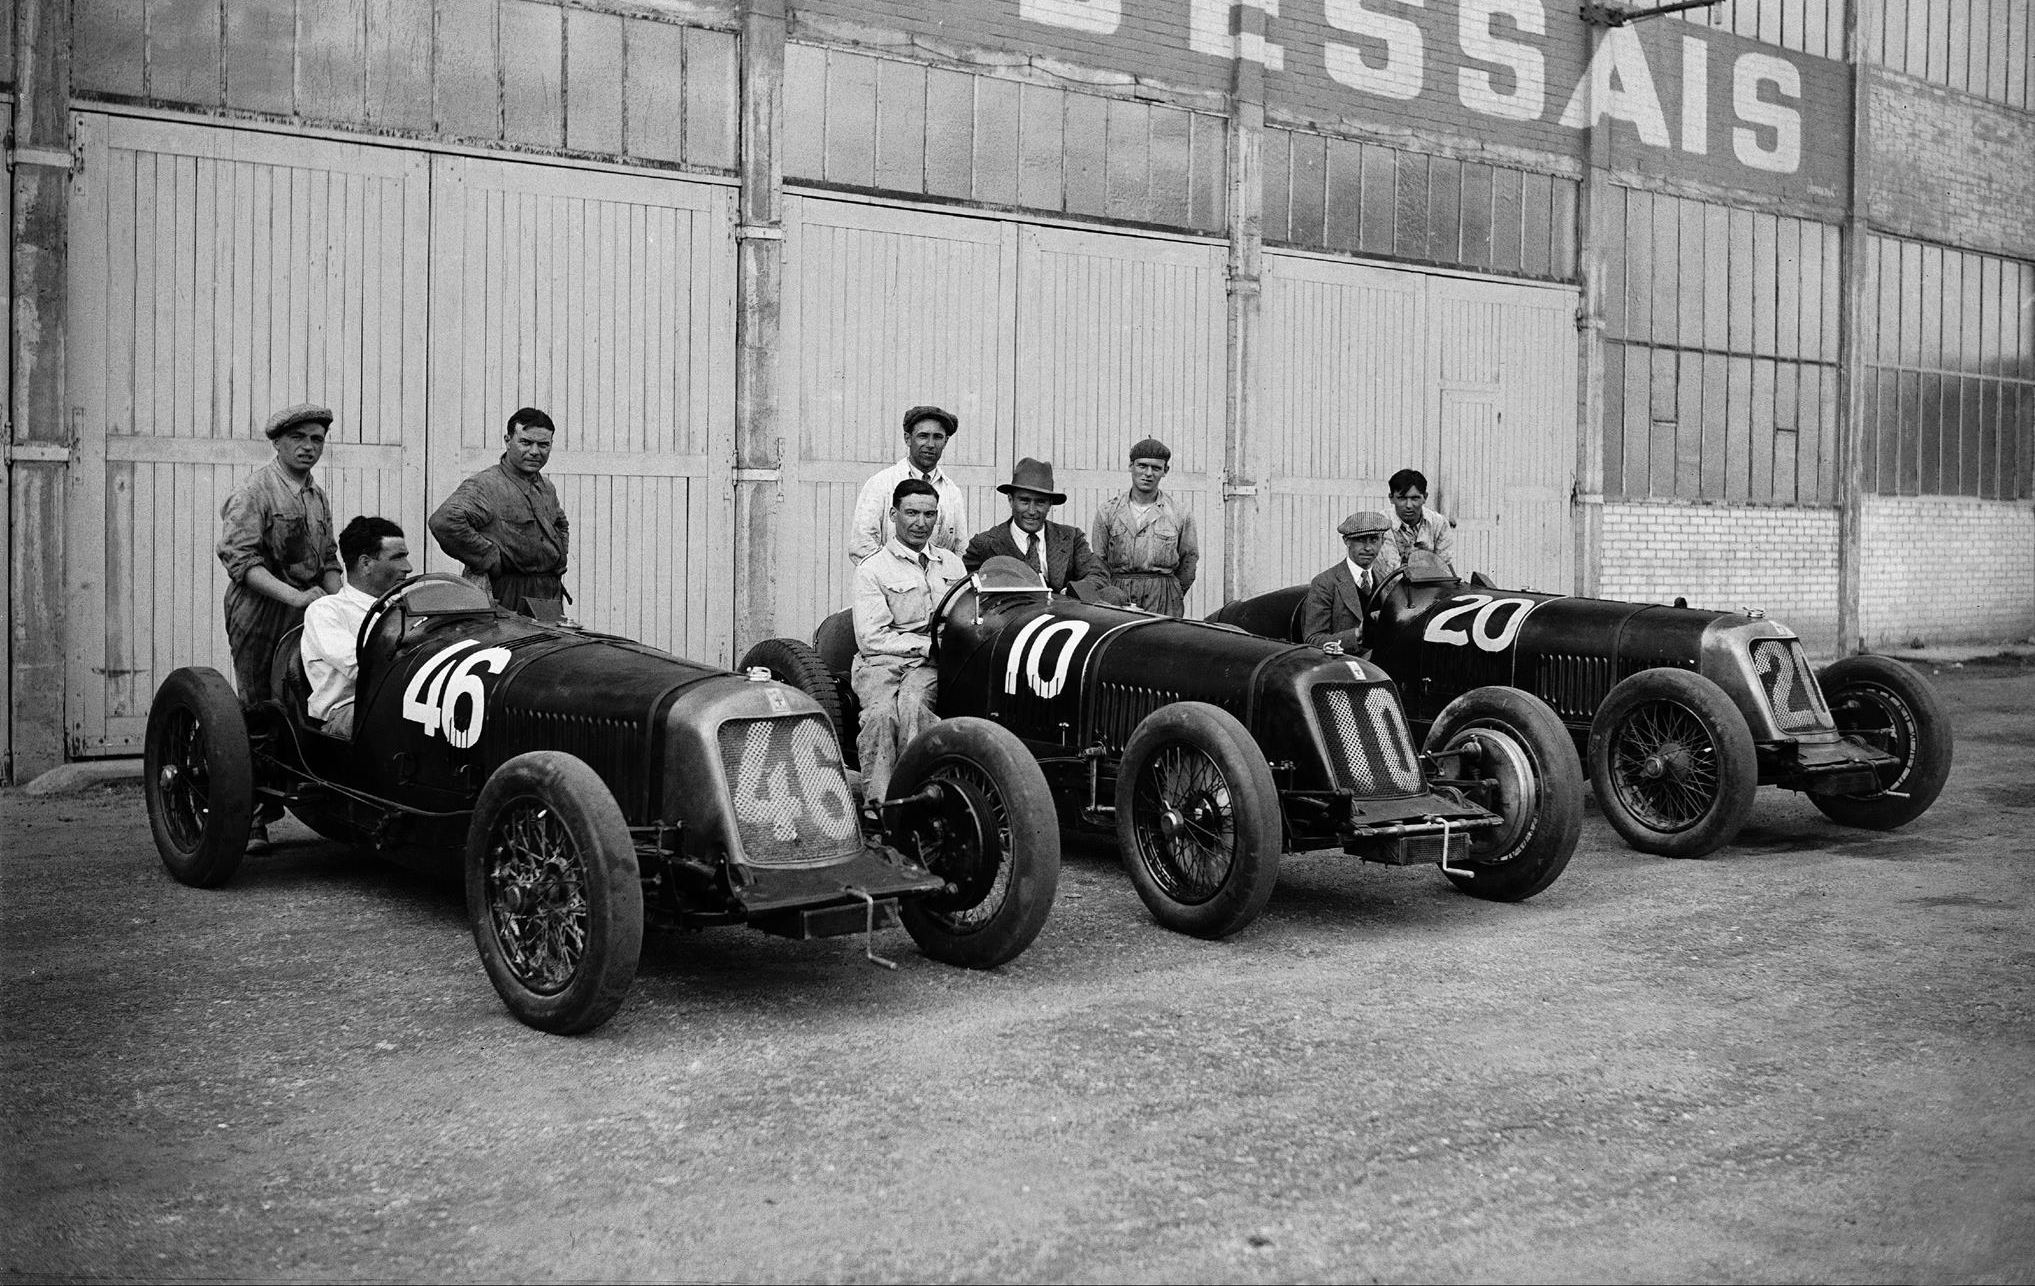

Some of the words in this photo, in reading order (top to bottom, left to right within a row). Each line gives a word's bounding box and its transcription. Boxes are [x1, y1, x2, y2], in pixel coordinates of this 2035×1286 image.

[1019, 0, 1801, 174] SSAIS
[1004, 613, 1091, 699] 10
[1423, 594, 1536, 653] 20
[402, 638, 513, 750] 46
[1326, 687, 1421, 794] 10
[735, 717, 856, 841] 46
